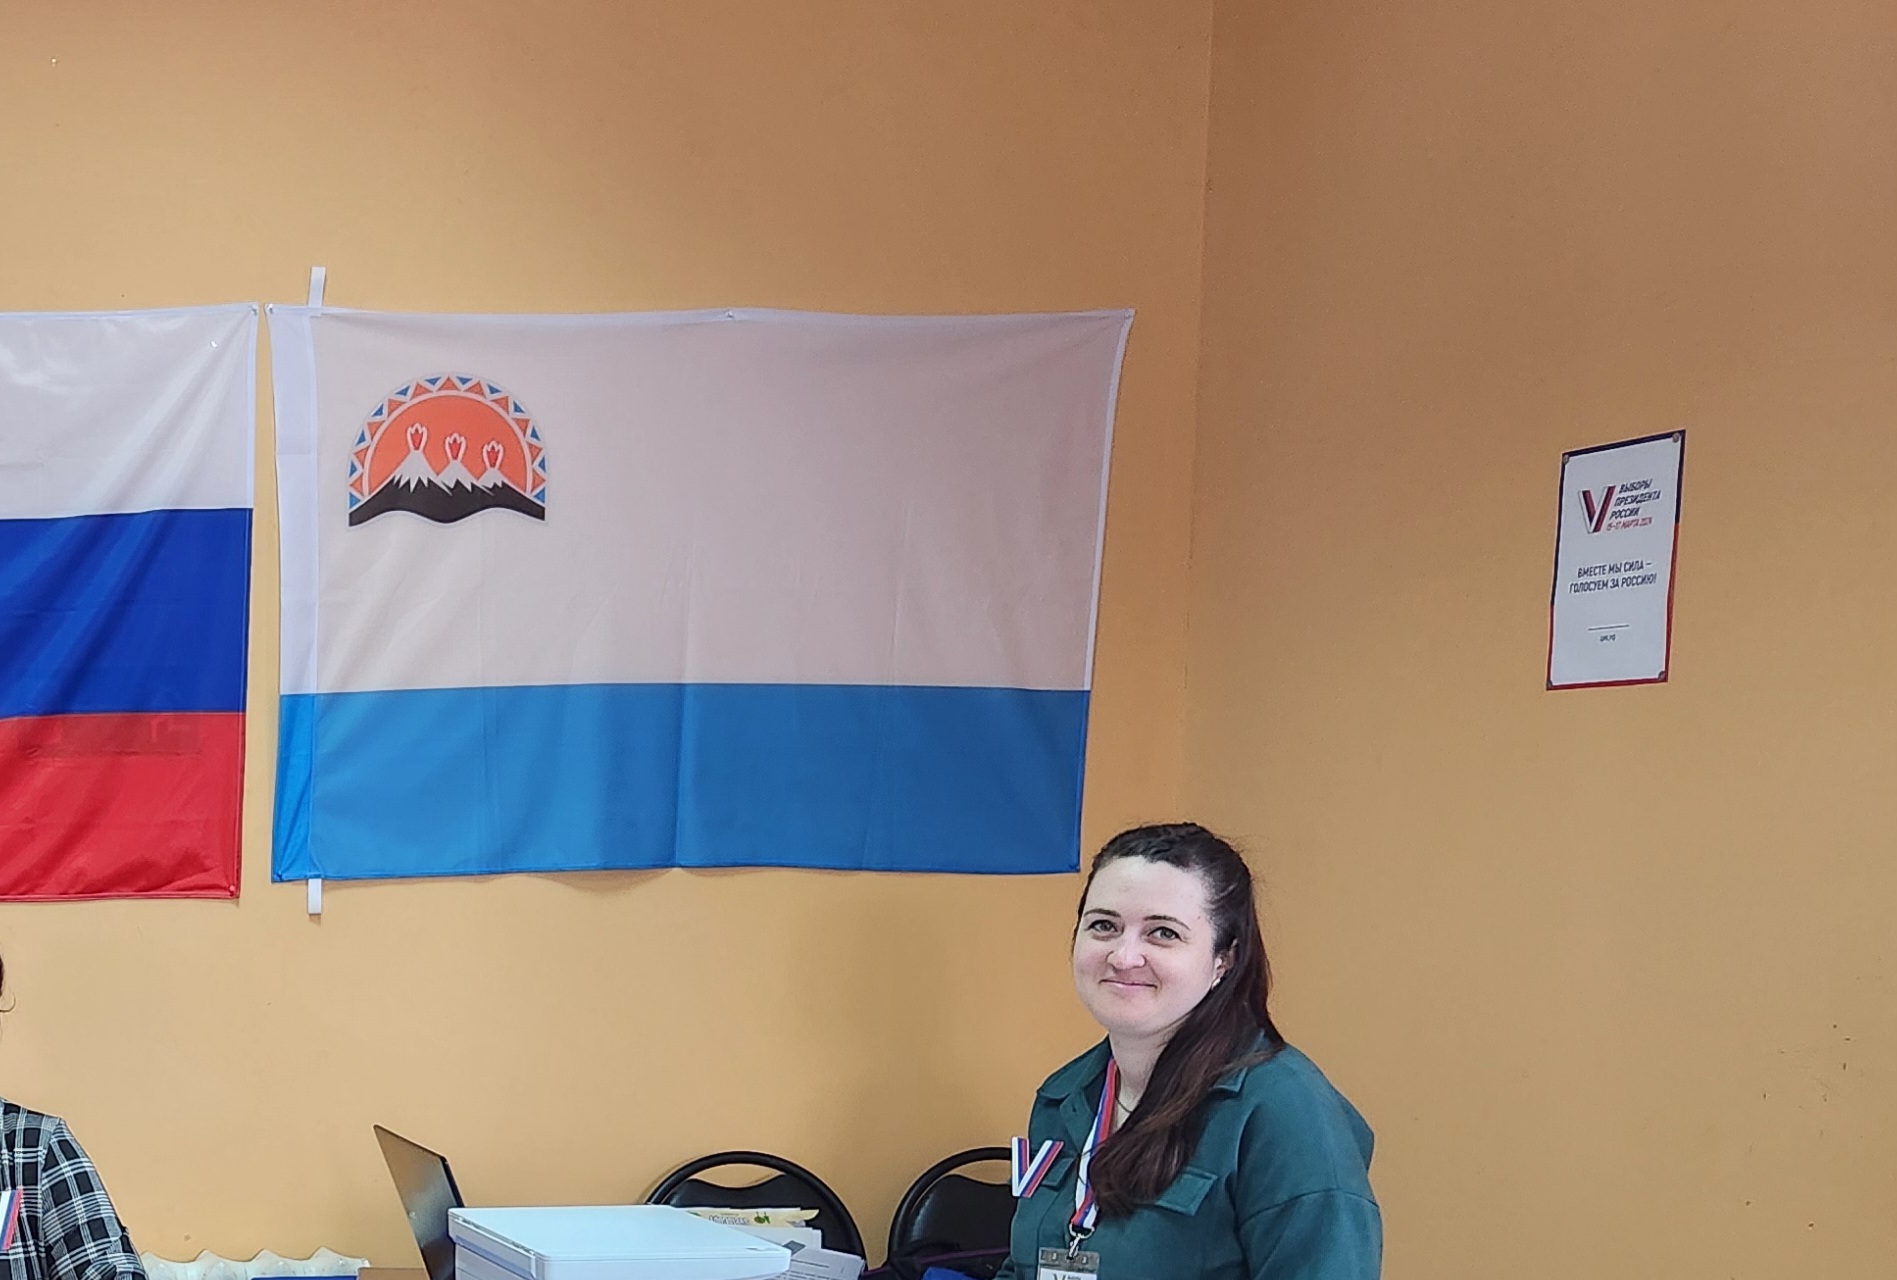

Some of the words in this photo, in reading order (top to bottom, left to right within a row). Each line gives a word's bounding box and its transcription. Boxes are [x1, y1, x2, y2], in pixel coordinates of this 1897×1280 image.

[1619, 479, 1653, 494] ВЫБОРЫ
[1614, 490, 1661, 507] ПРЕЗИДЕНТА
[1609, 507, 1640, 520] РОССИИ
[1578, 564, 1607, 578] ВМЕСТЕ
[1608, 562, 1622, 574] МЫ
[1624, 560, 1644, 572] СИЛА
[1569, 580, 1608, 594] ГОЛОСУЕМ
[1610, 578, 1619, 589] ЗА
[1621, 573, 1657, 588] РОССИЮ!
